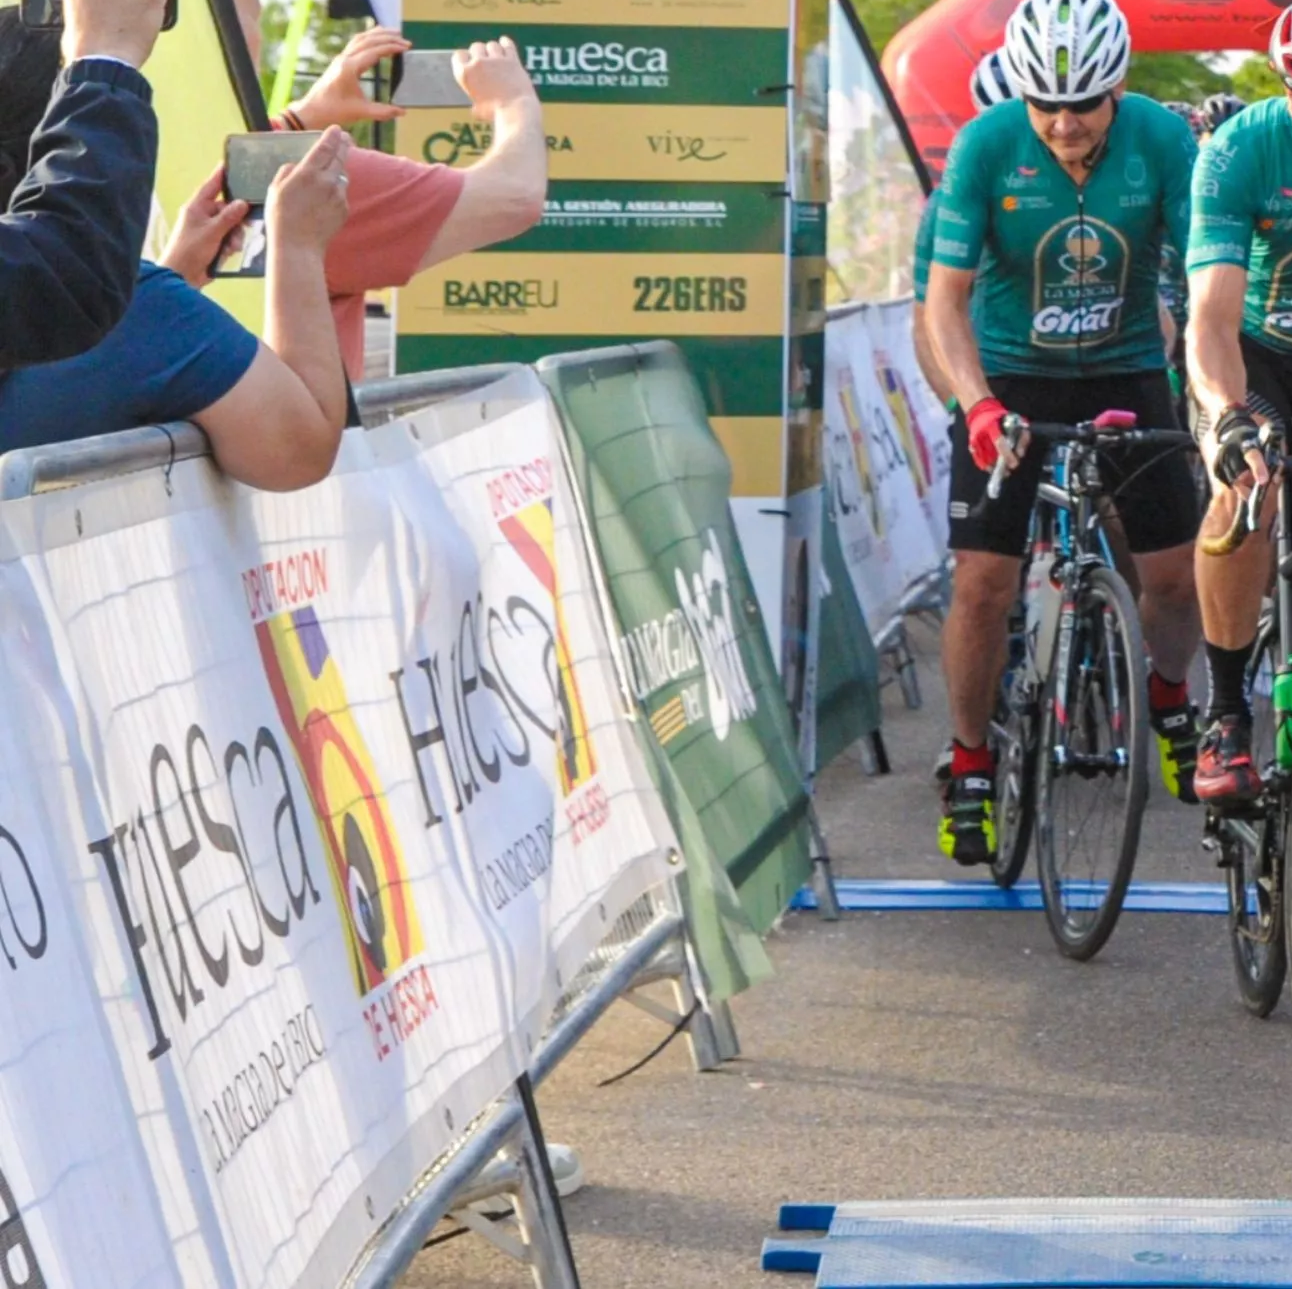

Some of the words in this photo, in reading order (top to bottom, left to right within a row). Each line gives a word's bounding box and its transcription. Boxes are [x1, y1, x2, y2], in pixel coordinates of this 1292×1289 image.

[525, 42, 669, 73] Huesca
[444, 280, 558, 308] BARREU
[633, 276, 747, 312] 226ERS
